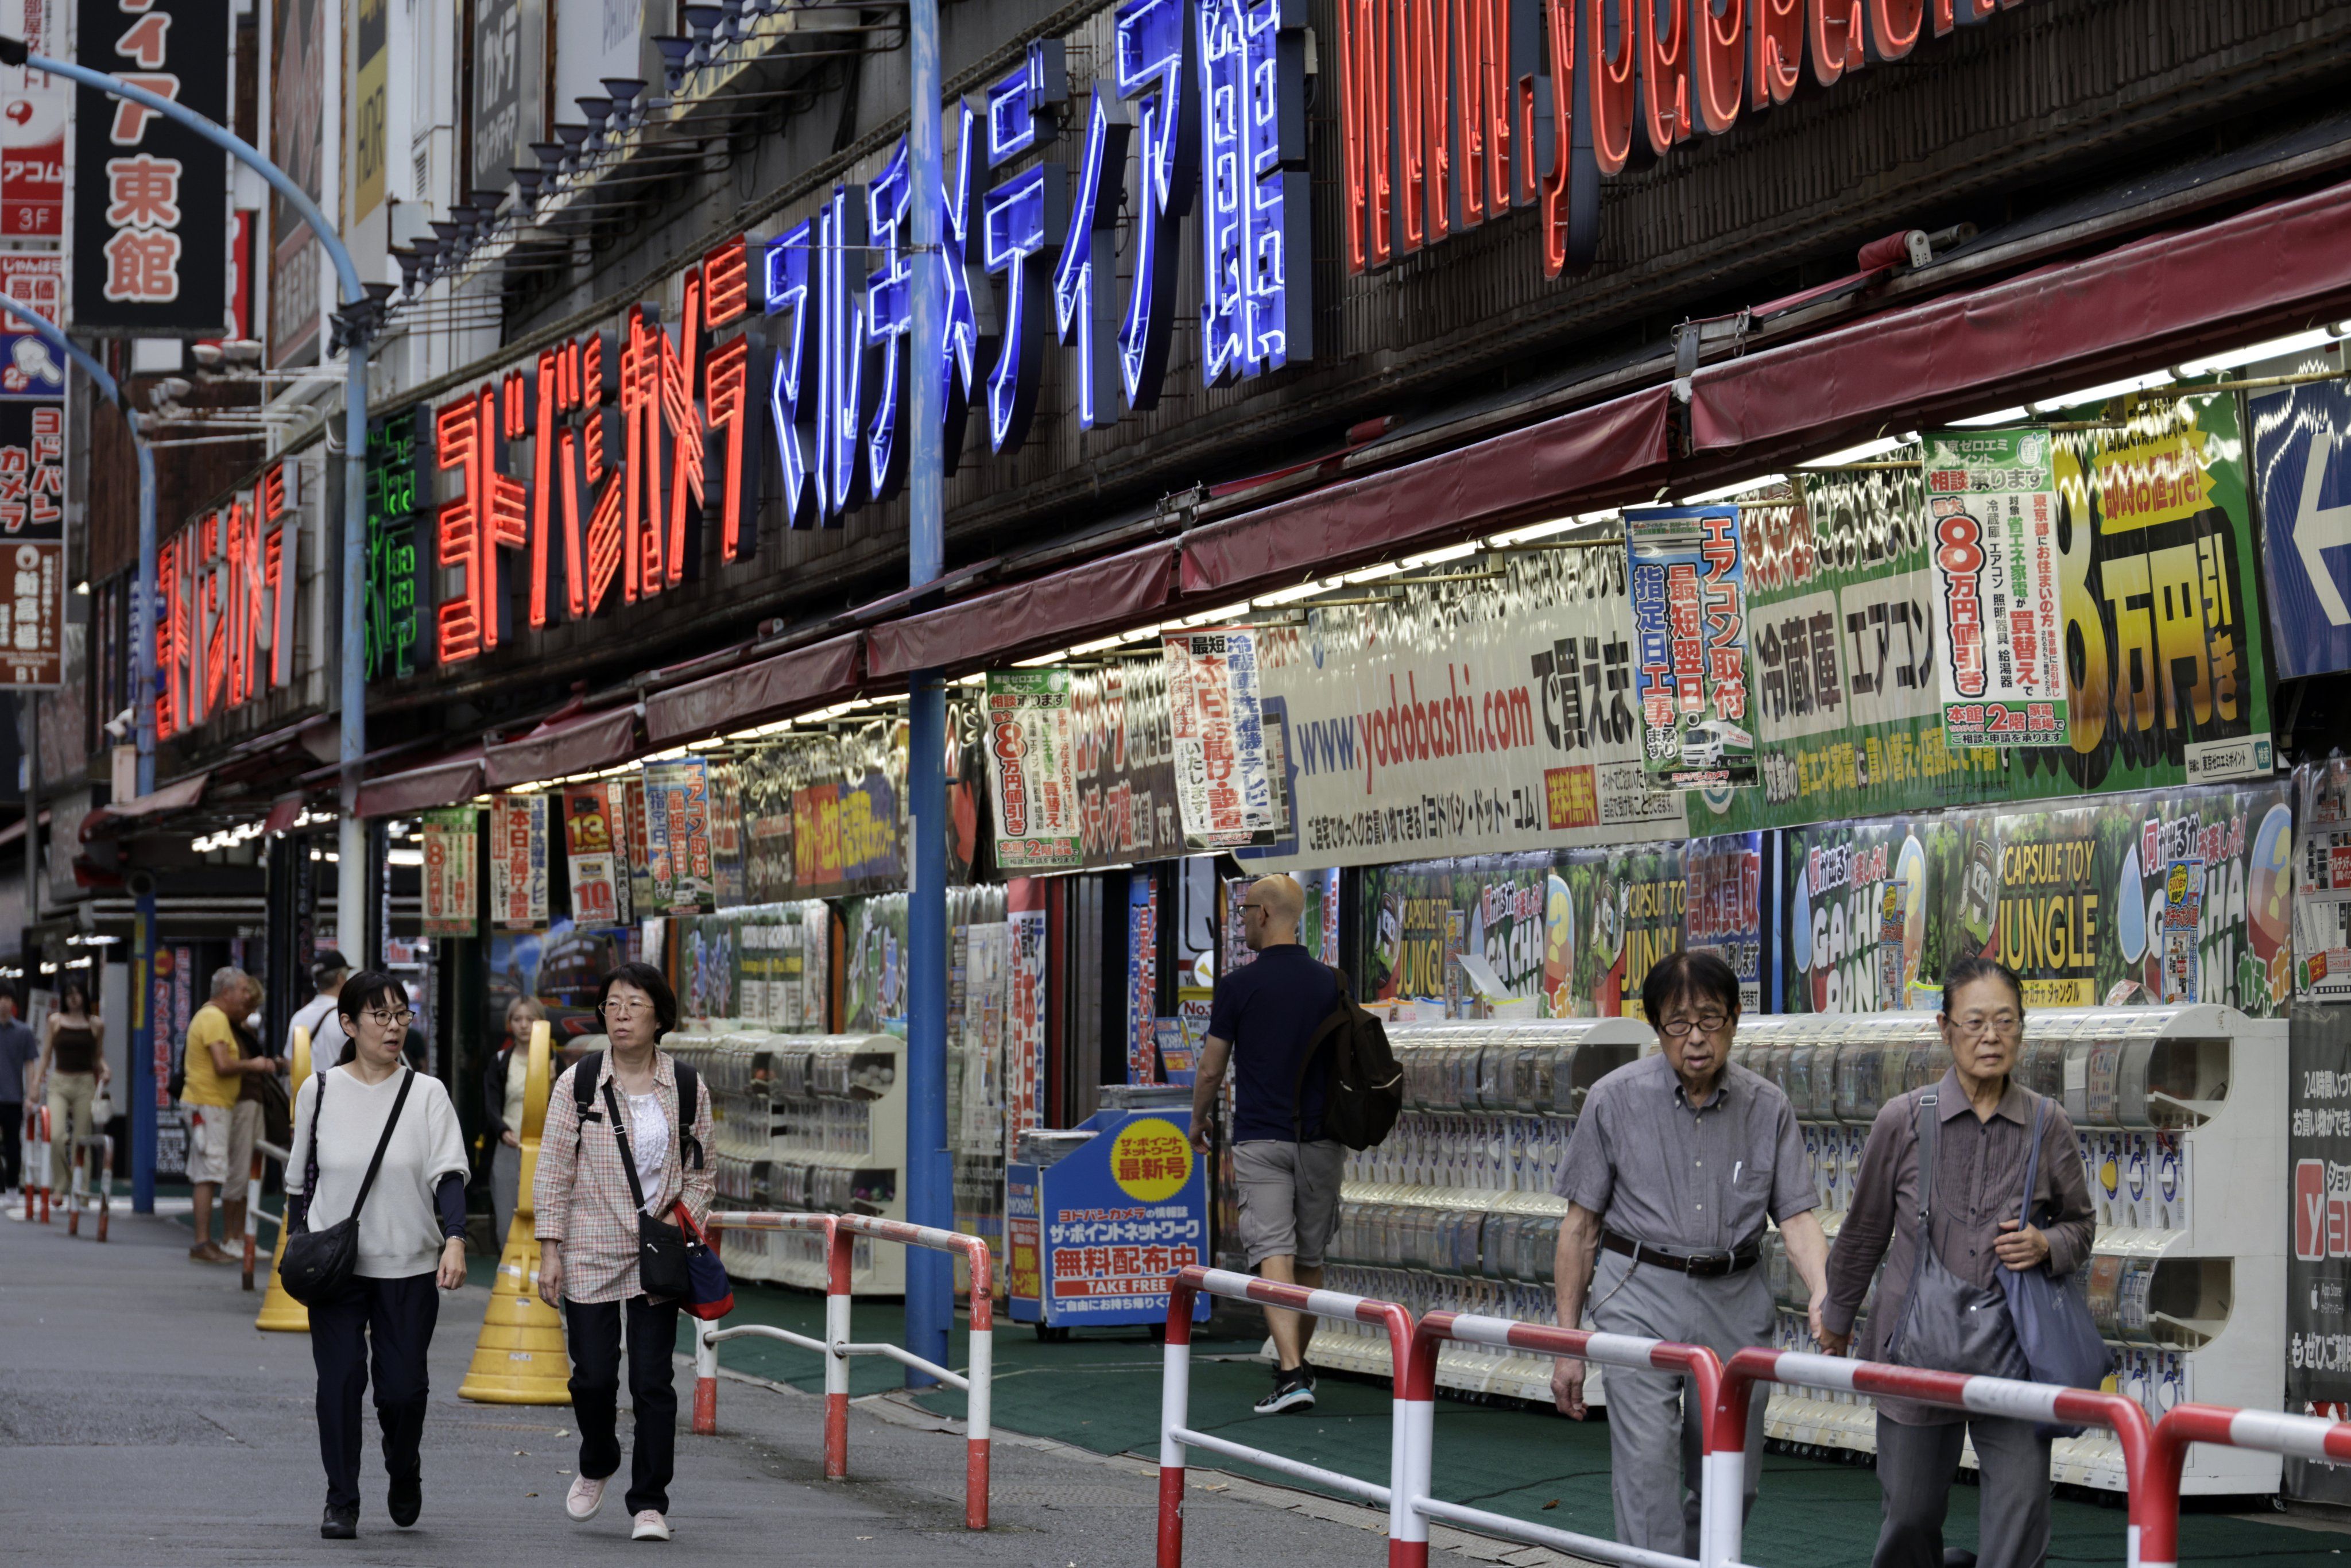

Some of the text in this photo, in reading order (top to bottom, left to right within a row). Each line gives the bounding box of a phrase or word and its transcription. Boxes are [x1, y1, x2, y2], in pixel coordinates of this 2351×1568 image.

[106, 0, 181, 302] ィア東館
[2, 161, 65, 184] アコム
[18, 207, 50, 230] 3F
[3, 366, 28, 390] 2F
[435, 233, 747, 666] ヨドバシカメラ
[1934, 439, 2008, 452] 東京ゼロエミ
[1950, 454, 1994, 467] ポイント
[30, 408, 61, 524] ヨドバシ
[1930, 467, 2047, 493] 相談承ります
[0, 446, 27, 533] カメラ
[2033, 494, 2054, 628] 東京都にお住まいの方
[1932, 498, 1983, 694] 最大 8万円値引き
[1986, 500, 2013, 688] 冷蔵庫 エアコン 照明器具 給湯器
[1702, 518, 1746, 721] エアコン取付
[1191, 635, 1226, 655] 最短
[1635, 565, 1674, 728] 指定日工事
[1755, 610, 1842, 723] 冷蔵庫
[1848, 599, 1933, 697] エアコン
[2042, 630, 2051, 697] される方もご相談ください
[2047, 630, 2060, 698] 東京都にお引越し
[994, 675, 1042, 684] 東京ゼロエミ
[1003, 684, 1033, 692] ポイント
[1226, 635, 1268, 807] 冷蔵庫・洗濯機・テレビ
[1297, 663, 1535, 795] www.yodobashi.com
[1532, 631, 1635, 752] で買えま
[1947, 703, 2027, 733] 本館 2階
[2027, 703, 2054, 717] 家電
[2028, 717, 2066, 731] 売場で
[1194, 655, 1244, 831] 本日お届け・設置
[1952, 732, 2062, 744] ご相談・申請を承ります
[992, 711, 1025, 834] 最大 8万円値引き
[2202, 750, 2246, 771] 東京ゼロエミポイント
[2258, 746, 2269, 764] 検索
[1185, 742, 1207, 828] いたします!
[1672, 770, 1730, 782] ヨドバシカメラ
[1548, 769, 1595, 824] 送料無料
[686, 764, 710, 877] エアコン取付
[1308, 783, 1541, 850] ご自宅でゆっくりお買い物できる「ヨドバシ・ドット・コム」
[1025, 839, 1053, 857] 2階
[2142, 811, 2247, 878] 何が出るかお楽しみ!
[2004, 840, 2096, 886] CAPSULE TOY
[1669, 880, 1687, 915] TO
[1687, 849, 1760, 940] 高額買取
[2148, 858, 2245, 959] GHA
[1404, 899, 1435, 930] CAPSULE
[2164, 904, 2199, 928] ガチャポン館
[1995, 895, 2098, 970] JUNGLE
[1397, 939, 1445, 995] JUNGL
[2023, 982, 2080, 1005] ャガチャ ジャングル
[2303, 1070, 2351, 1099] 24時間いつ
[1121, 1137, 1182, 1147] ザ・ポイント
[1121, 1147, 1182, 1156] ネットワーク
[1119, 1157, 1187, 1181] 最新号
[1059, 1206, 1188, 1222] ヨドバシカメラの情報誌
[1049, 1219, 1200, 1244] ザ・ポイントネットワーク
[1054, 1242, 1199, 1279] 無料配布中
[1087, 1279, 1167, 1294] TAKE FREE
[2321, 1283, 2342, 1297] App Store
[1055, 1297, 1200, 1313] ご自由にお持ち帰りくい
[2321, 1303, 2345, 1314] からダウンロード
